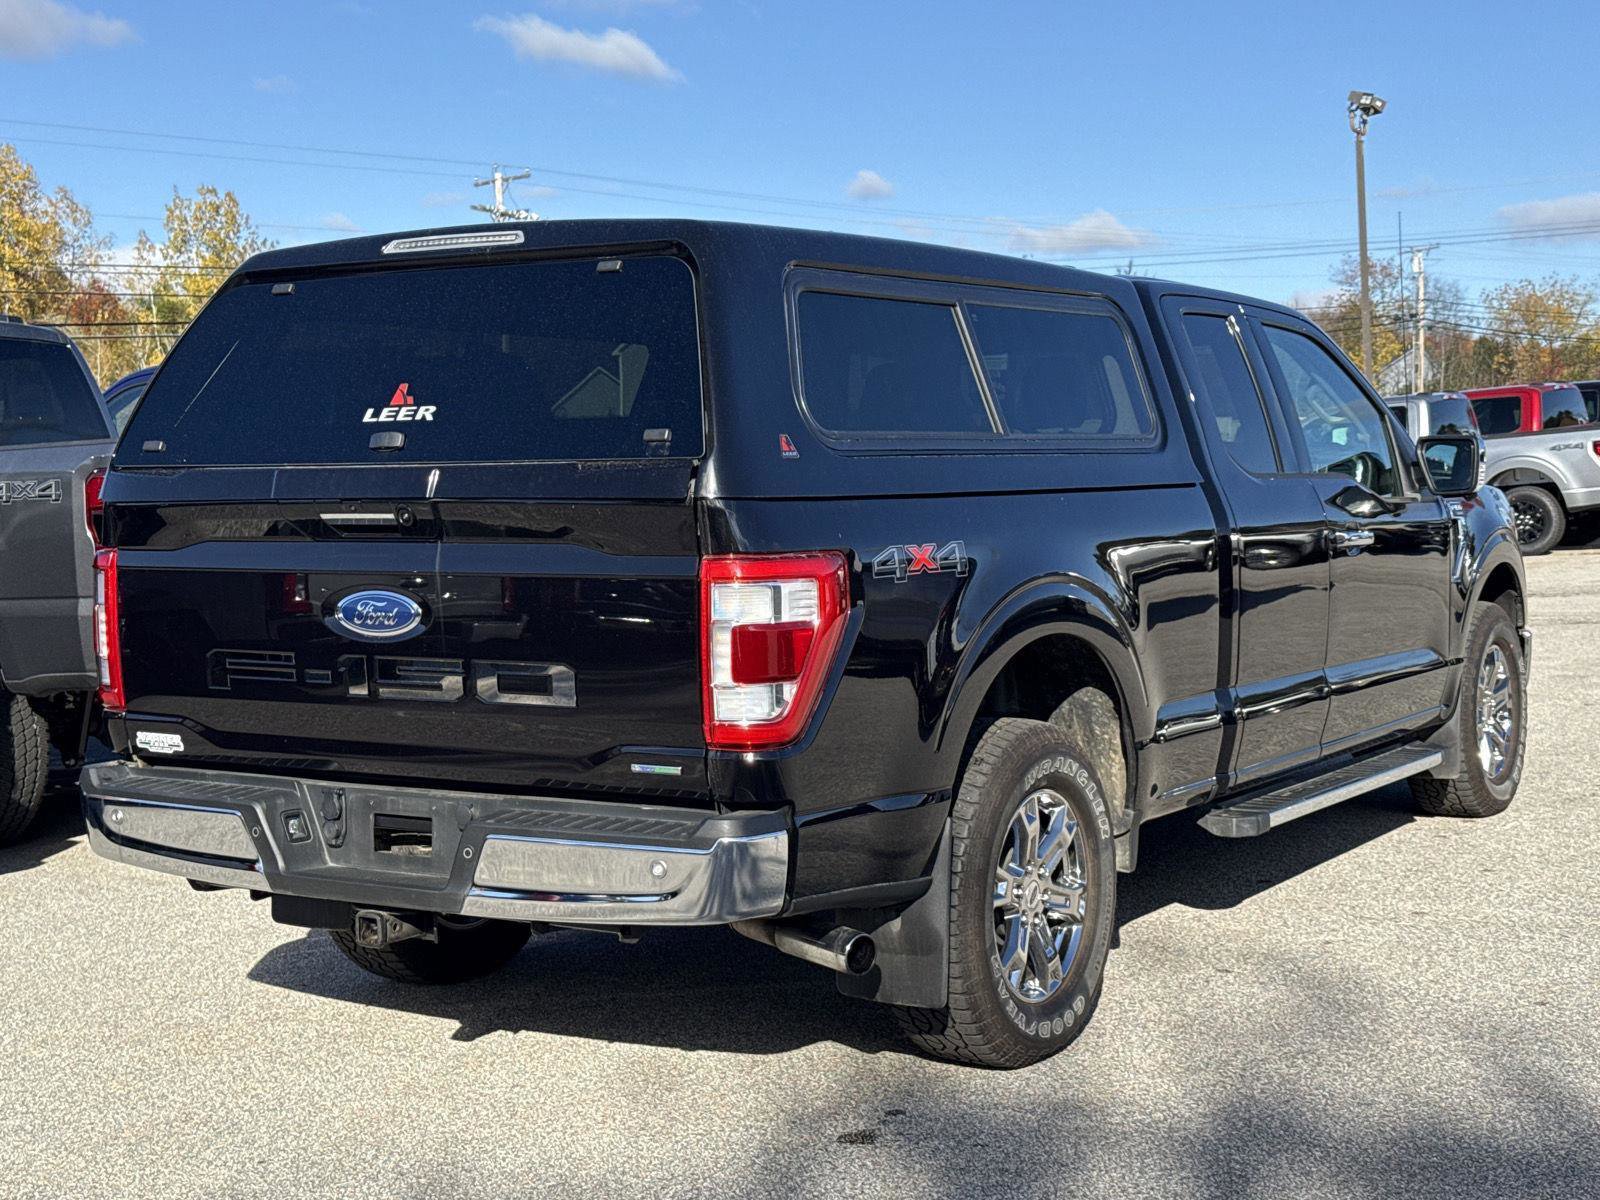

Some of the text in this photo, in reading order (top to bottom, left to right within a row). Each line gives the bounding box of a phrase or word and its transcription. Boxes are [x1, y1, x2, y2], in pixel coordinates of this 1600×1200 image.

[362, 405, 437, 423] LEER
[872, 541, 969, 583] 4X4
[353, 600, 399, 626] Ford
[206, 649, 578, 708] F-150
[1024, 756, 1111, 840] WRANGLER
[990, 954, 1086, 1038] GOODYEAR
